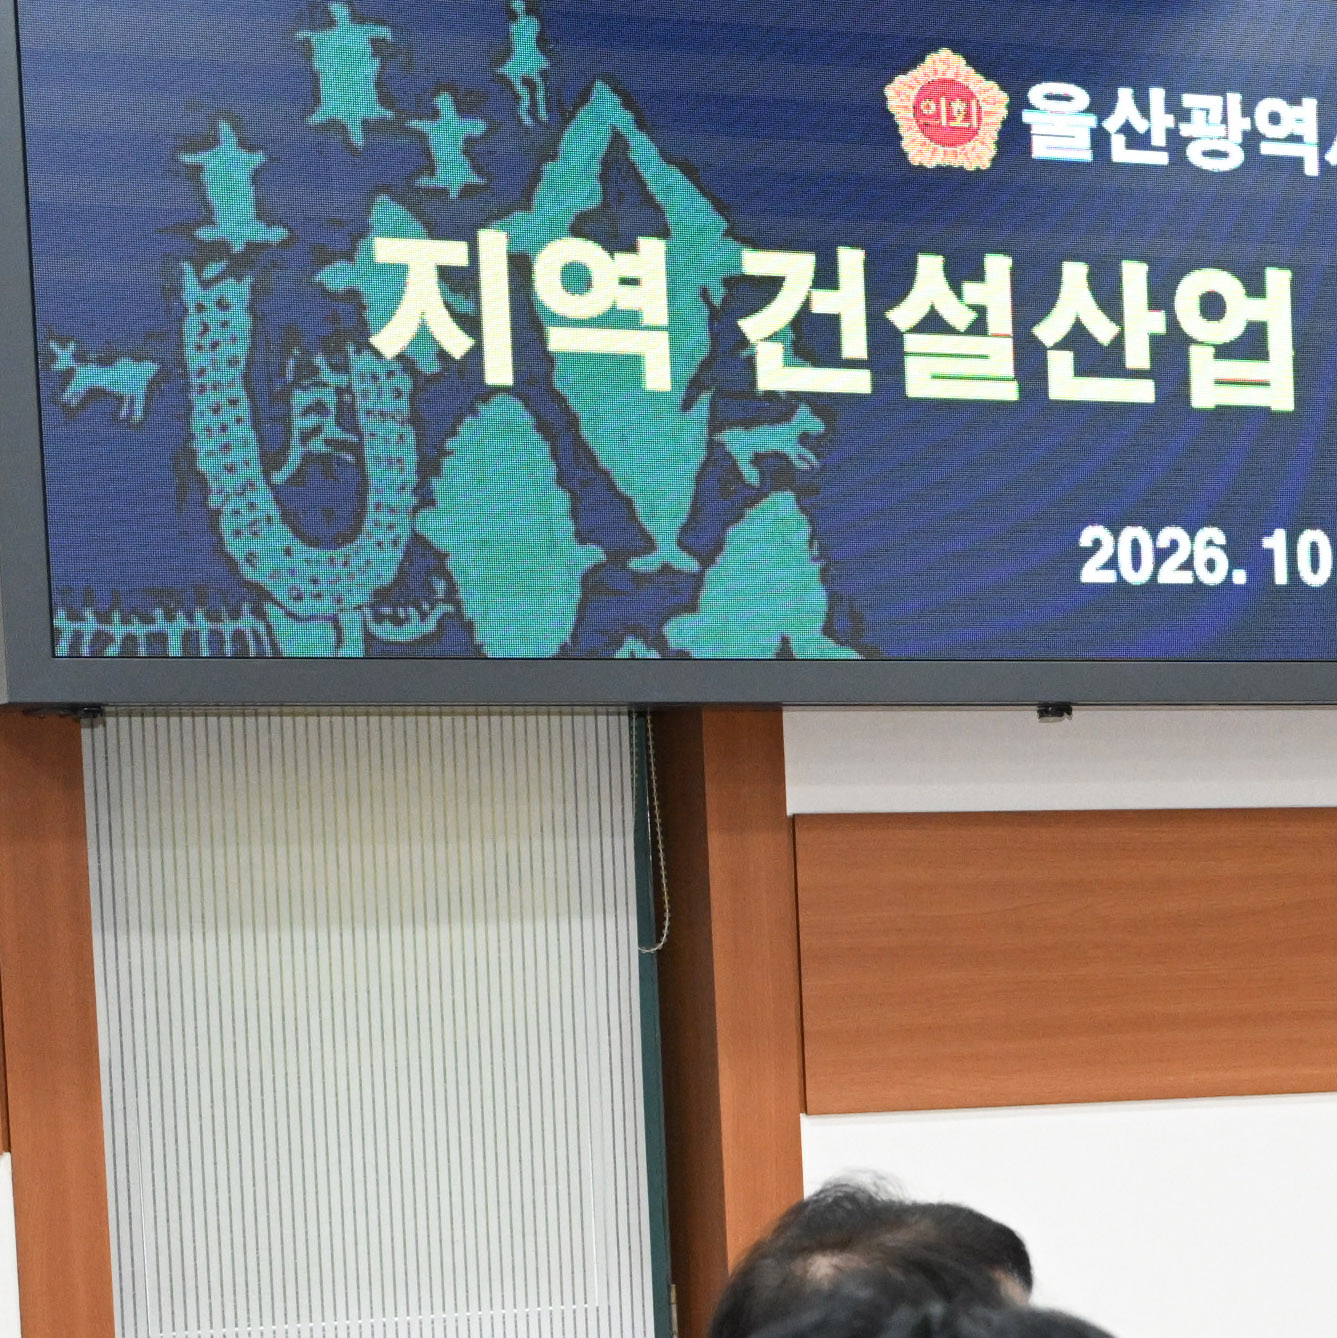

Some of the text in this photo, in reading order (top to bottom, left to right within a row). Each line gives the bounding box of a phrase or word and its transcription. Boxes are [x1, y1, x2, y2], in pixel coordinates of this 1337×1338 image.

[919, 96, 977, 128] 의회
[370, 228, 673, 393] 지역
[737, 246, 1296, 412] 건설산업
[1079, 525, 1248, 587] 2026.
